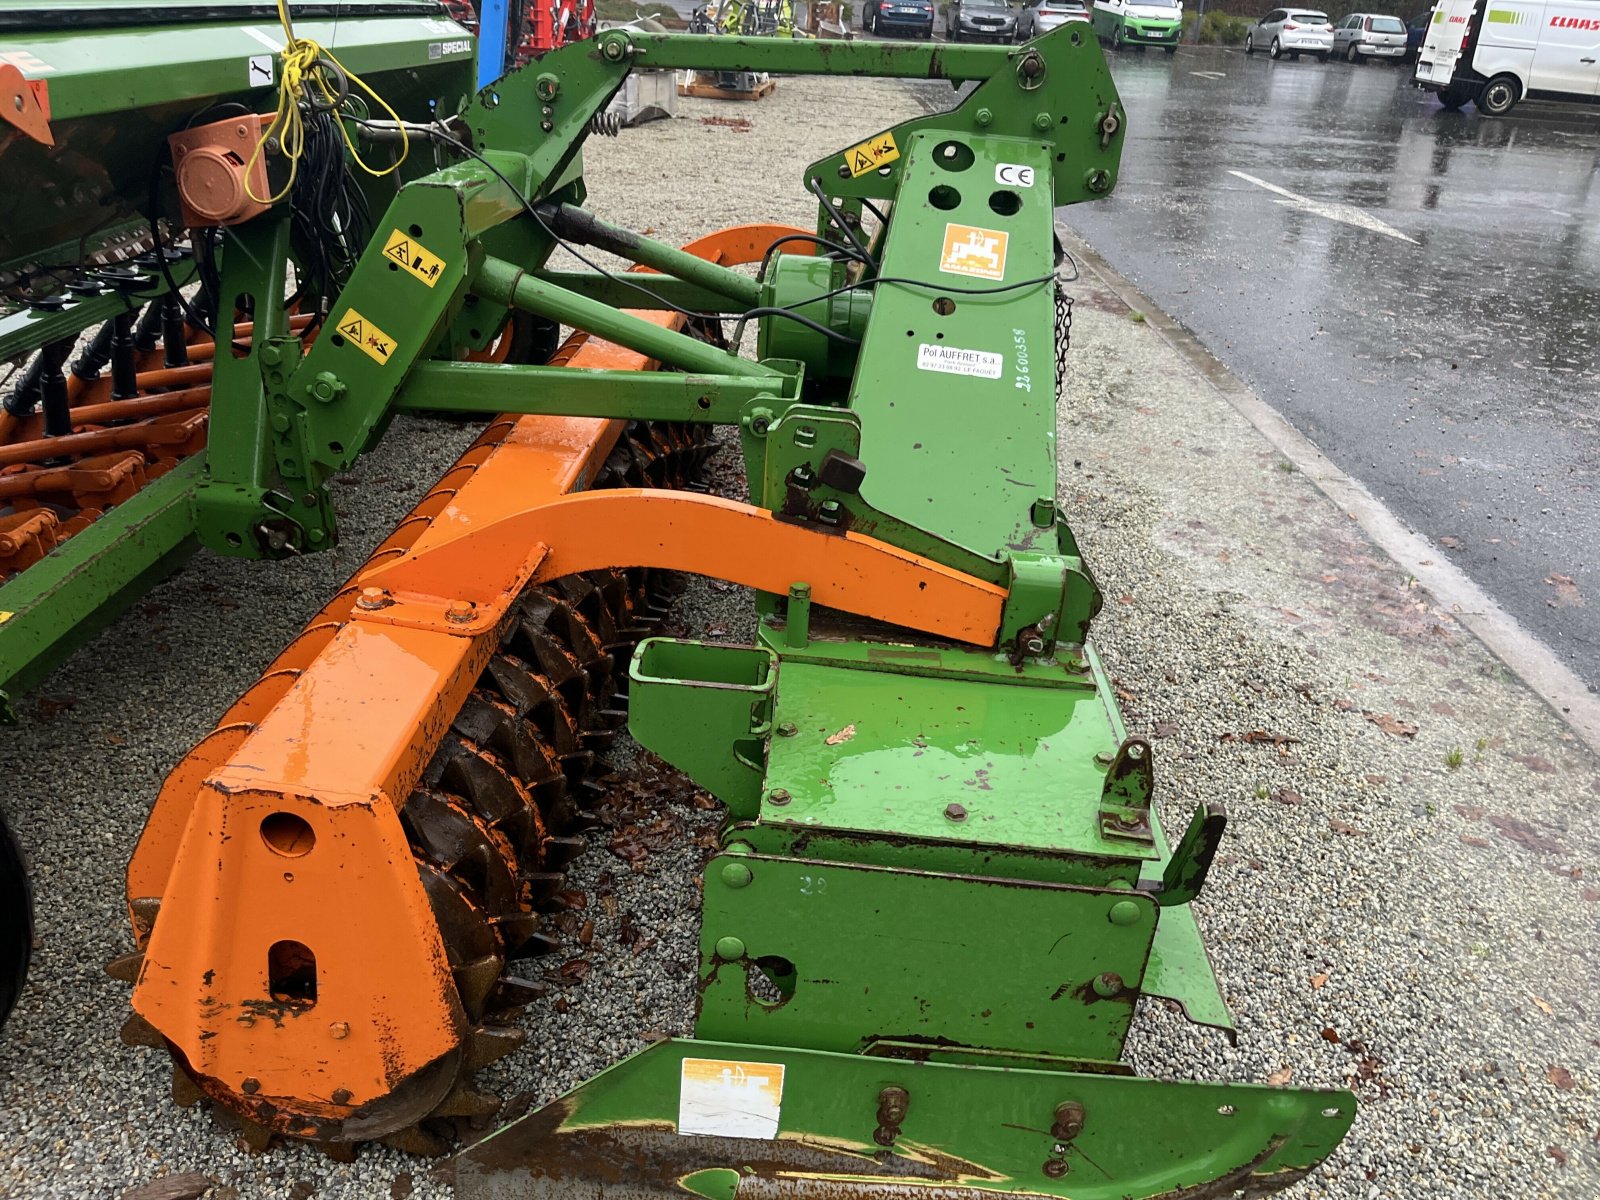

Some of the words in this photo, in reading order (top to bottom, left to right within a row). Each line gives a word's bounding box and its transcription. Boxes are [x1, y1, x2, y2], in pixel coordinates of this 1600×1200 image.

[1449, 16, 1466, 24] CLAAS
[1550, 16, 1600, 31] CLAAS
[442, 40, 471, 55] SPECIAL
[999, 167, 1031, 184] CE
[943, 263, 1001, 277] AMAZONE
[923, 347, 937, 357] Pol
[940, 349, 980, 363] AUFFRET
